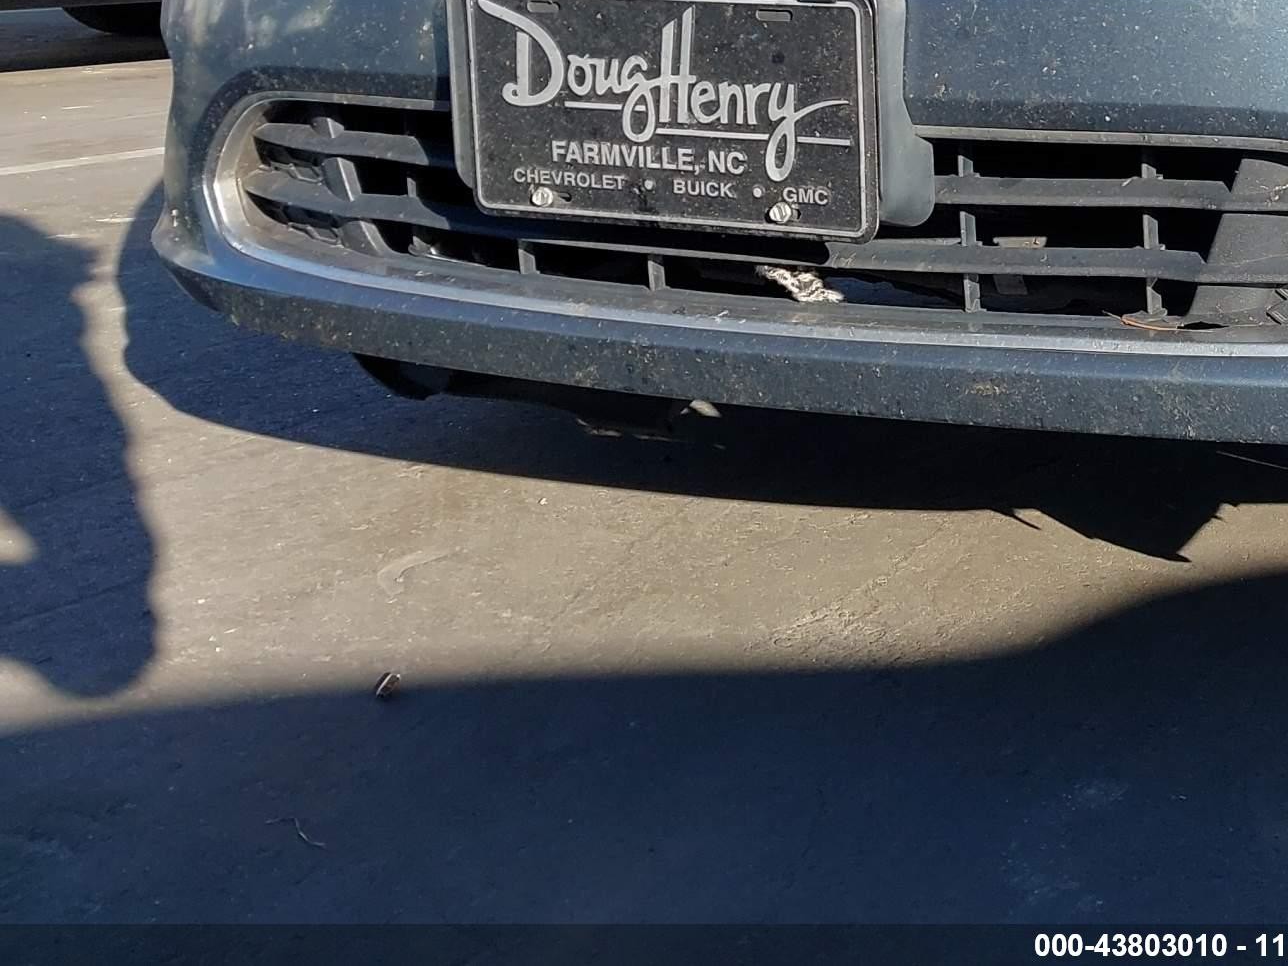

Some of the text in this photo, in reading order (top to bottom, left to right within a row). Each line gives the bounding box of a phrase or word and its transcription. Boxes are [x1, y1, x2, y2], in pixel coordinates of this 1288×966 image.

[652, 5, 850, 182] Henry
[551, 140, 746, 175] FARMVILLE, NC
[513, 168, 829, 205] CHEVROLET BUICK GMC
